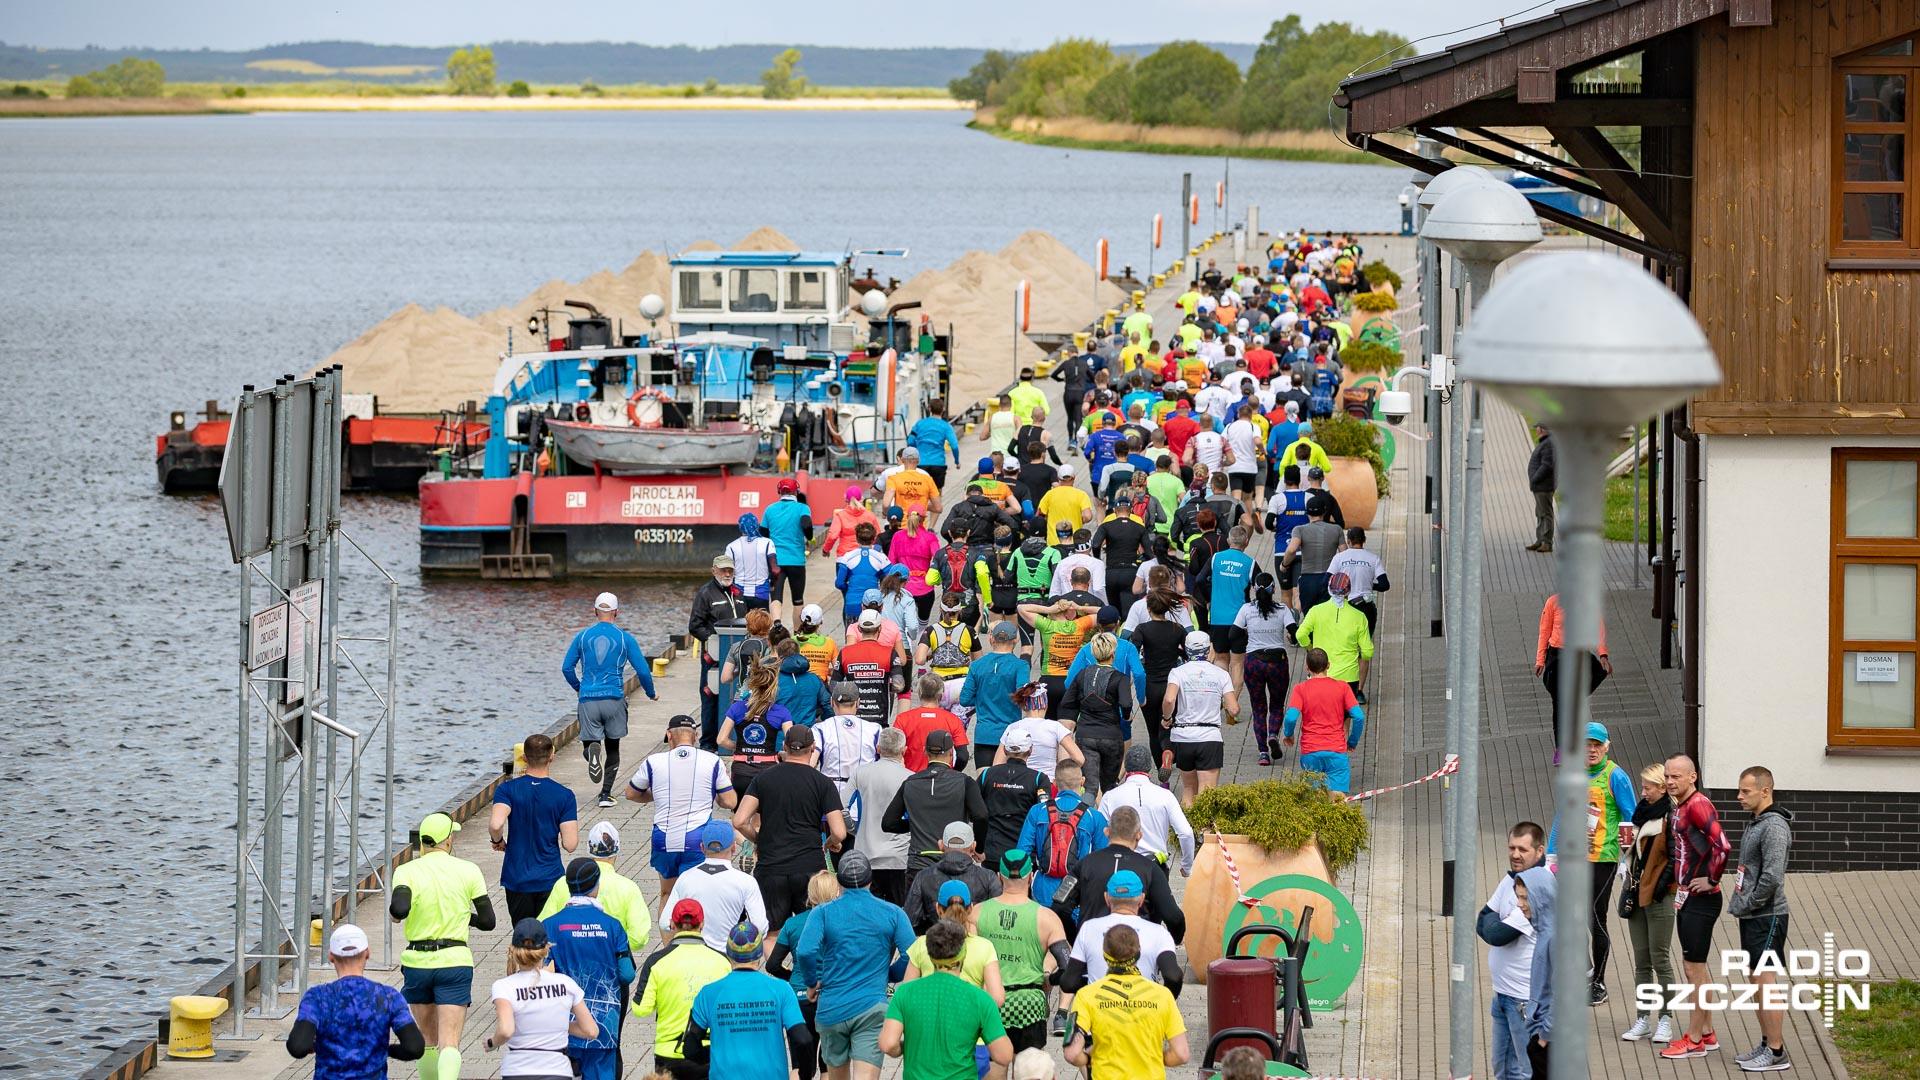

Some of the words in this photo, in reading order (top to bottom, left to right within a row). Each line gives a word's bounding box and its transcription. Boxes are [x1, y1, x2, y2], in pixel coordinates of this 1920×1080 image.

[632, 487, 695, 500] WROCŁAW
[567, 494, 584, 506] PL
[740, 494, 757, 506] PL
[634, 528, 694, 543] 08351026
[989, 933, 1022, 941] KOSZALIN
[515, 984, 567, 1001] JUSTYNA
[1099, 1000, 1158, 1010] RUNMAGEDDON
